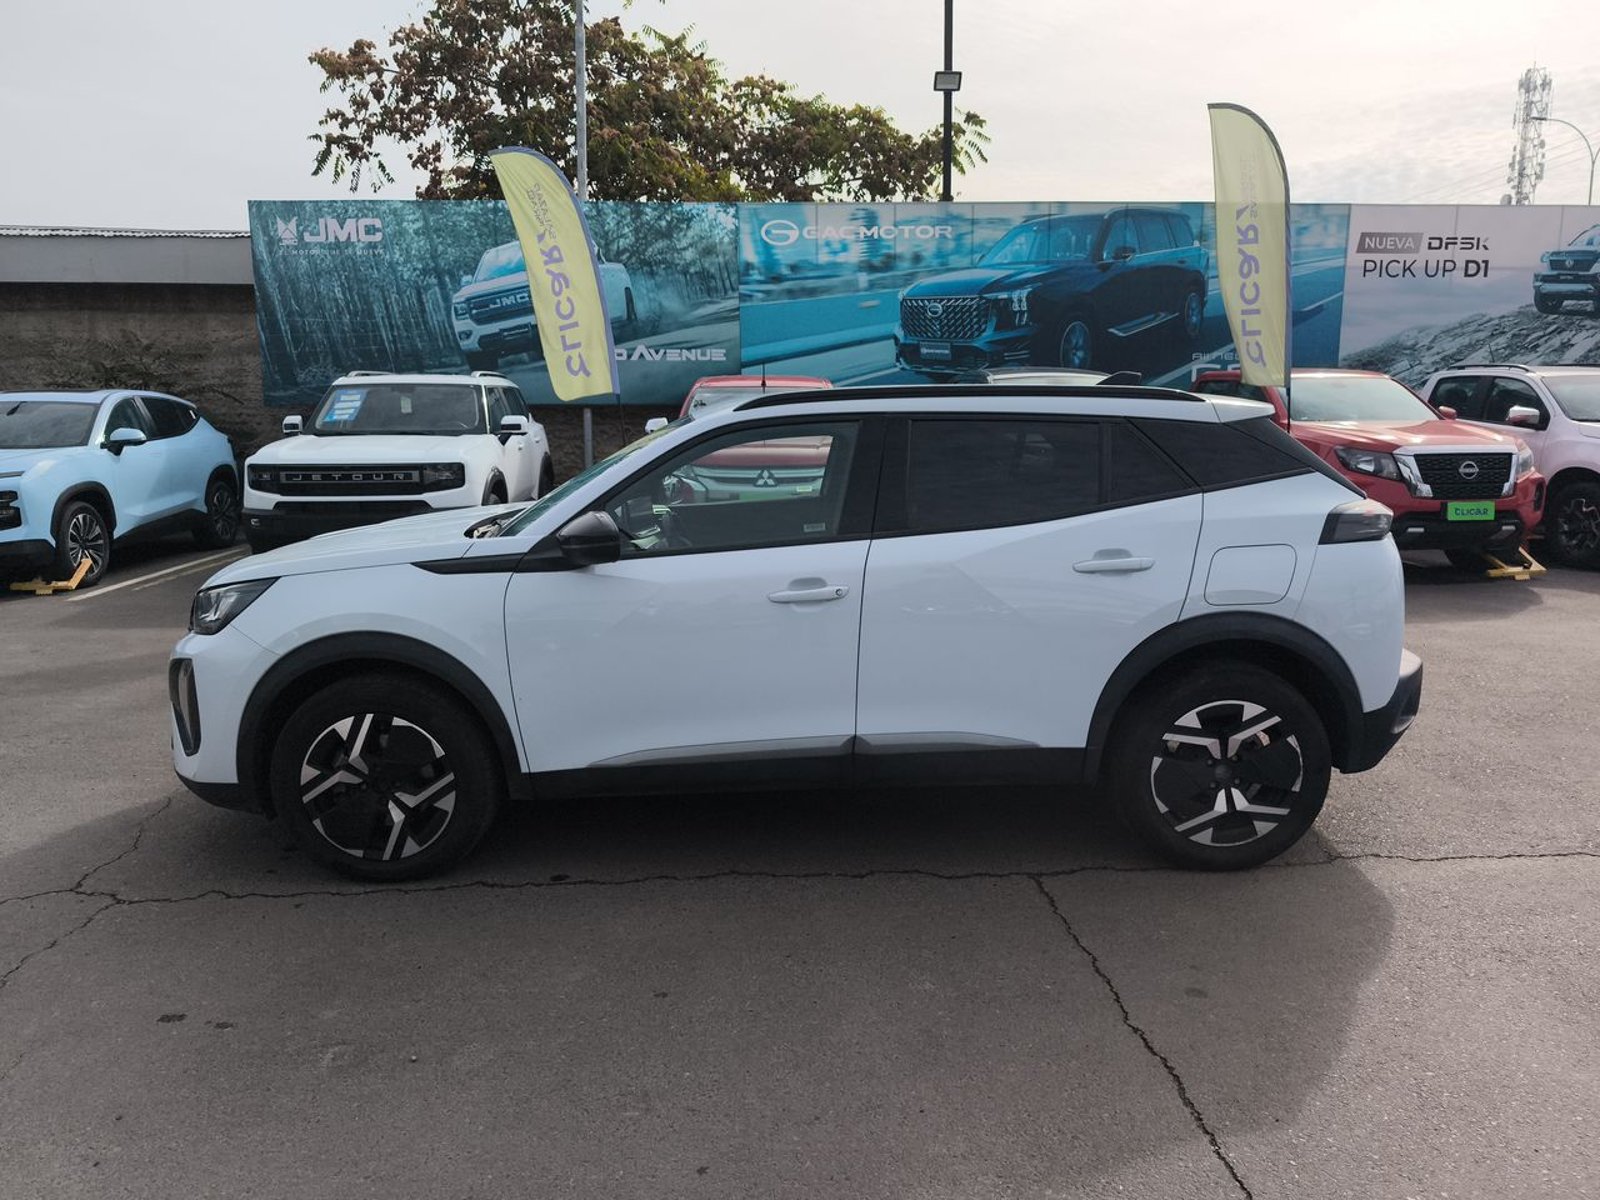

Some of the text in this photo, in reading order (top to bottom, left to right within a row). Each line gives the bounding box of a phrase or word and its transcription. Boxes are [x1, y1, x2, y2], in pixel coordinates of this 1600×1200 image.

[304, 218, 383, 242] JMC
[1364, 236, 1489, 251] NUEVA DFSK
[1362, 259, 1490, 278] PICK UP D1
[489, 292, 529, 308] JMC
[629, 344, 727, 361] AVENUE
[292, 473, 405, 481] JETOUR
